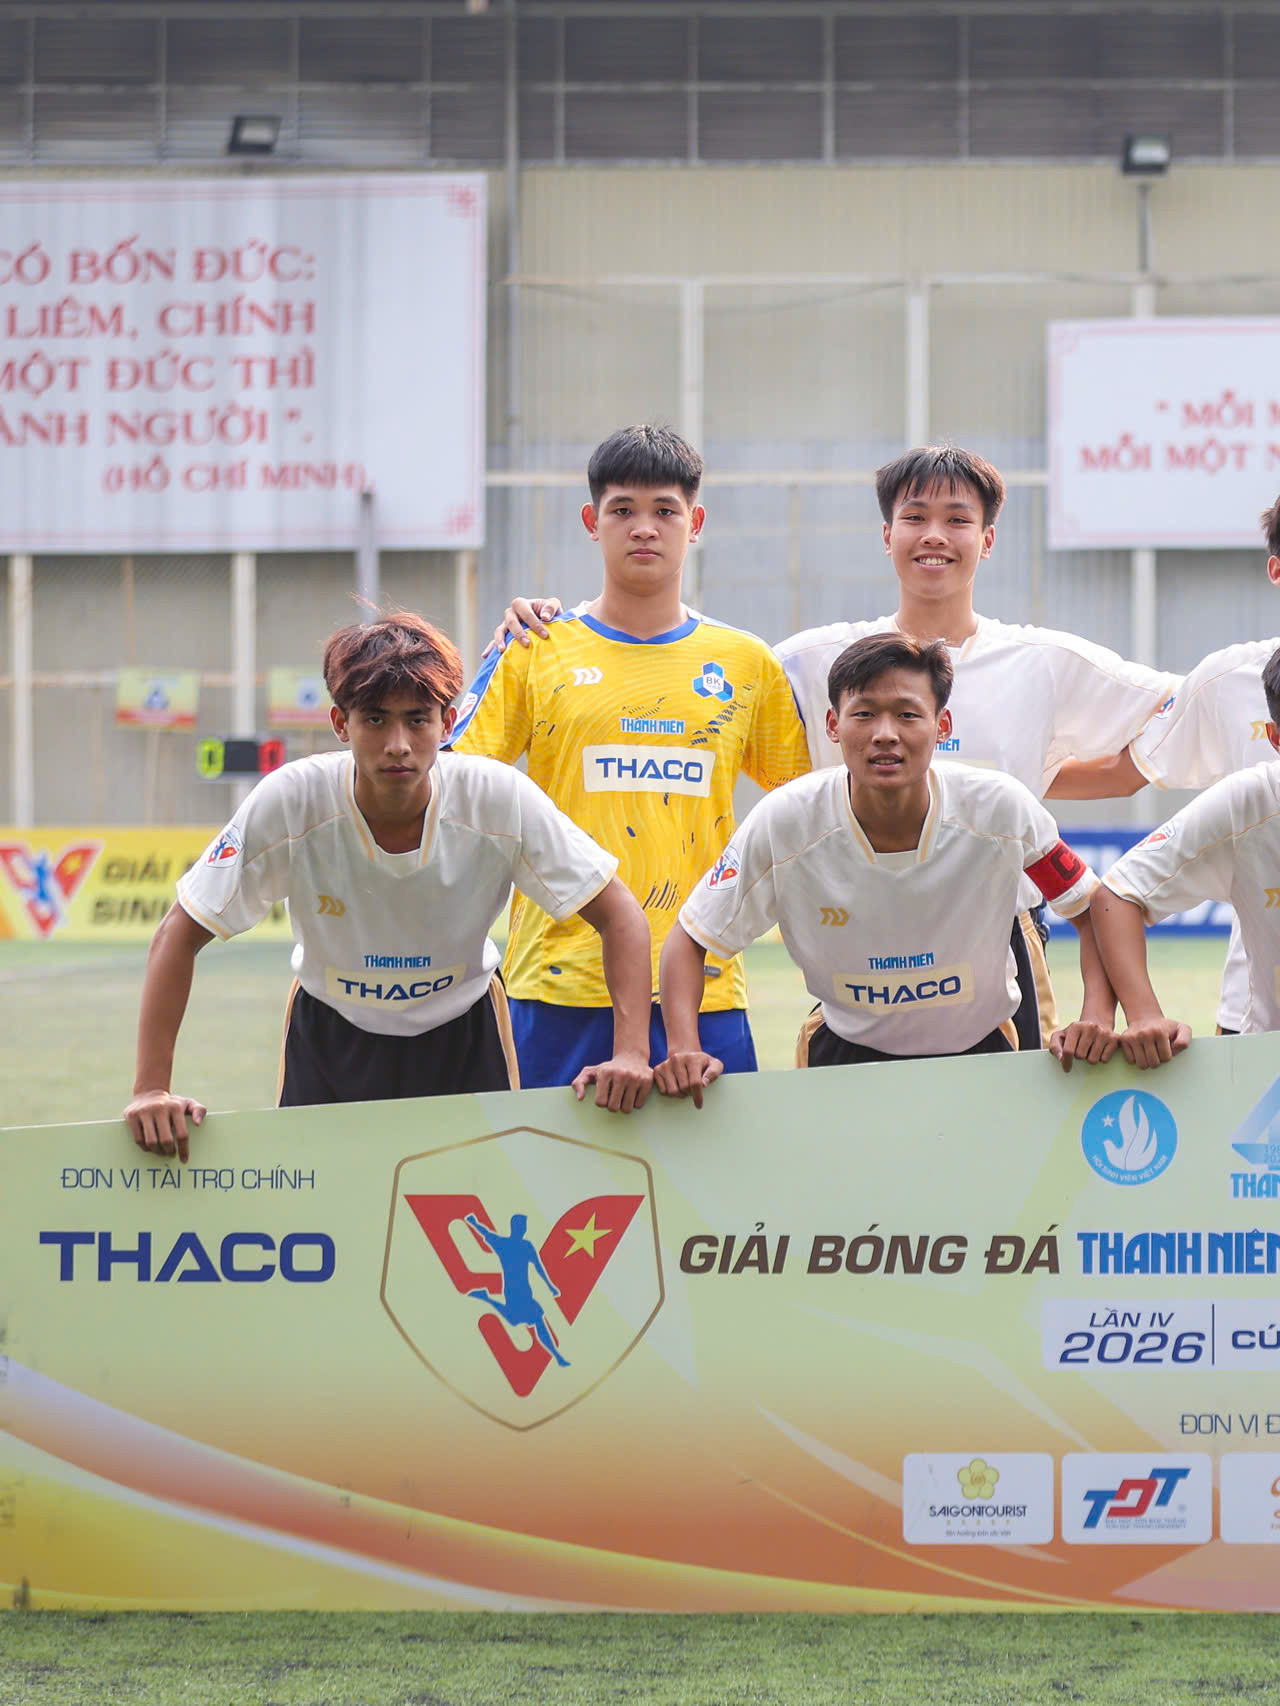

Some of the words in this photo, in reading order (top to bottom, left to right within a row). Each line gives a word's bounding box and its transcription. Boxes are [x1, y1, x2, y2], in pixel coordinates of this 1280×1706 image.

[69, 234, 177, 284] BỐN
[193, 239, 314, 283] ĐỨC:
[158, 294, 314, 338] CHÍNH
[104, 348, 215, 392] ĐỨC
[230, 344, 315, 390] THÌ
[104, 400, 269, 446] NGƯỜI
[706, 676, 721, 686] BK
[620, 718, 657, 733] THANH
[595, 757, 704, 783] THACO
[1051, 851, 1081, 882] C
[364, 954, 403, 969] THANH
[868, 956, 908, 970] THANH
[337, 974, 454, 1001] THACO
[845, 975, 961, 1005] THACO
[61, 1167, 113, 1189] ĐƠN
[120, 1168, 140, 1192] VỊ
[147, 1163, 181, 1189] TÀI
[188, 1167, 235, 1192] TRỢ
[242, 1163, 315, 1189] CHÍNH
[39, 1231, 336, 1282] THACO
[679, 1222, 790, 1275] GIẢI
[806, 1224, 968, 1275] BÓNG
[984, 1224, 1060, 1275] ĐÁ
[1077, 1232, 1201, 1275] THANH
[1089, 1307, 1141, 1328] LẦN
[1149, 1311, 1174, 1328] IV
[1059, 1331, 1205, 1364] 2026
[1179, 1413, 1232, 1435] ĐƠN
[1239, 1413, 1259, 1438] VỊ
[929, 1505, 1027, 1518] SAIGONTOURIST
